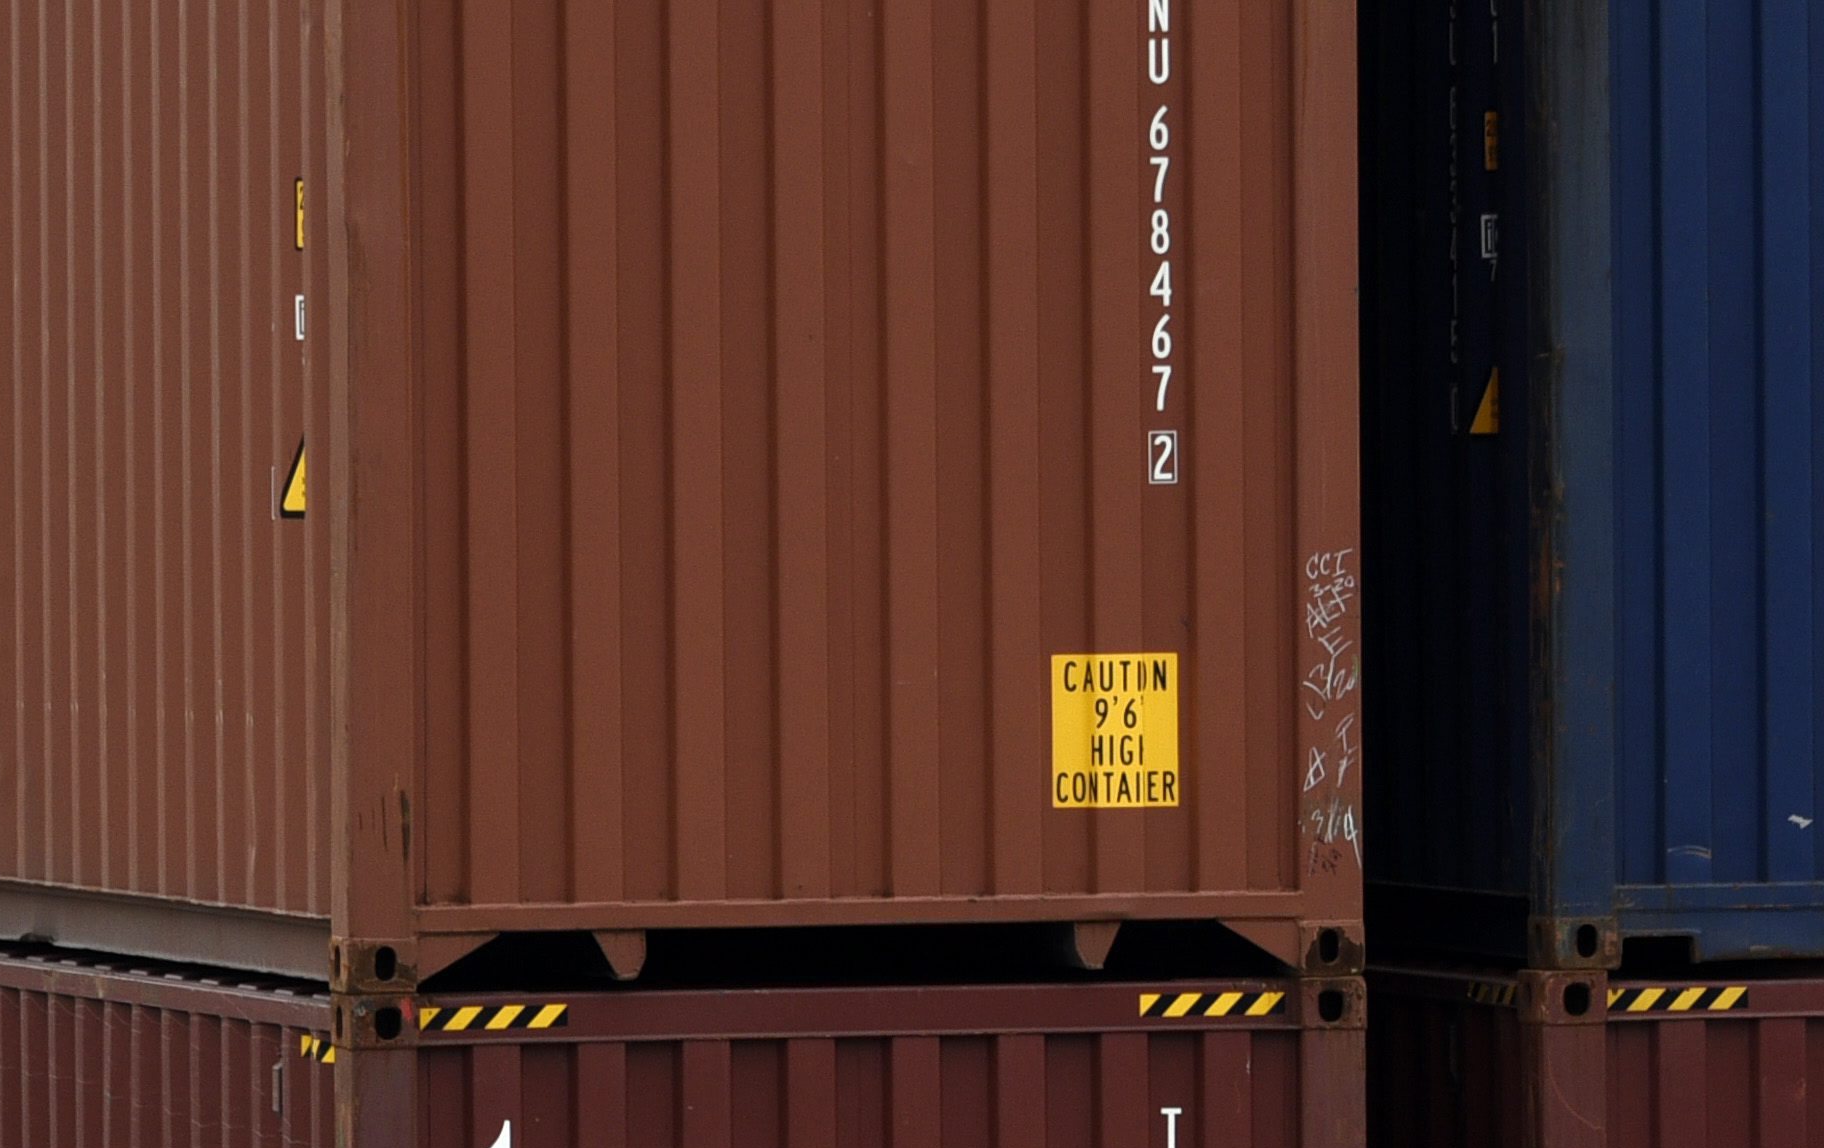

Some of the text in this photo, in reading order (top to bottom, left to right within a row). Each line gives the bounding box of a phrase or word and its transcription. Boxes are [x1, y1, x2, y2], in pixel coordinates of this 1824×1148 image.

[1149, 105, 1172, 411] 678467
[1153, 435, 1172, 481] 2
[1056, 771, 1176, 803] CONTAIER
